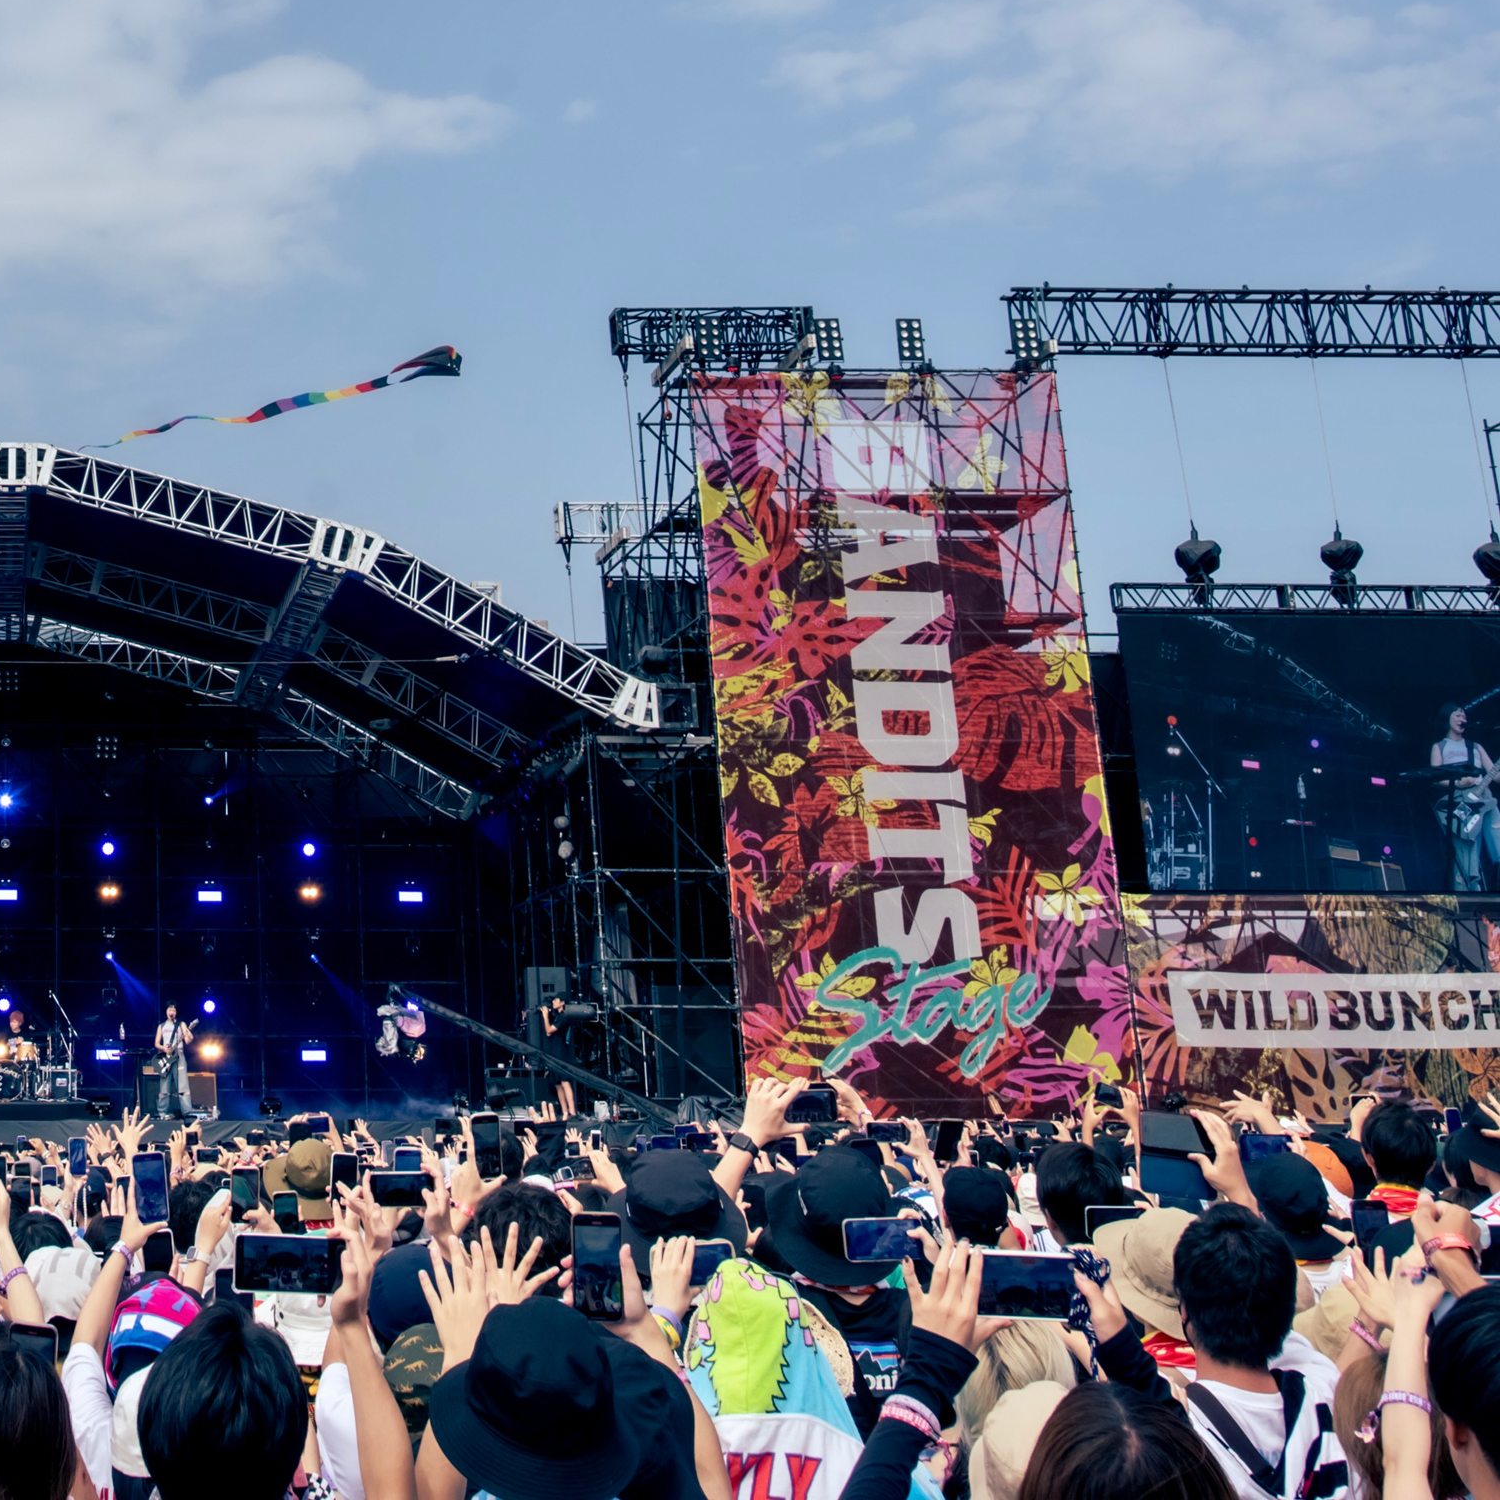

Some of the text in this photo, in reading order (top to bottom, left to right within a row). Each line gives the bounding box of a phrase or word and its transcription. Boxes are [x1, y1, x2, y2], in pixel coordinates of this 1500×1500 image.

[828, 419, 982, 967] BANDITS
[813, 946, 1052, 1078] Stage
[1187, 988, 1500, 1032] WILD BUNCH
